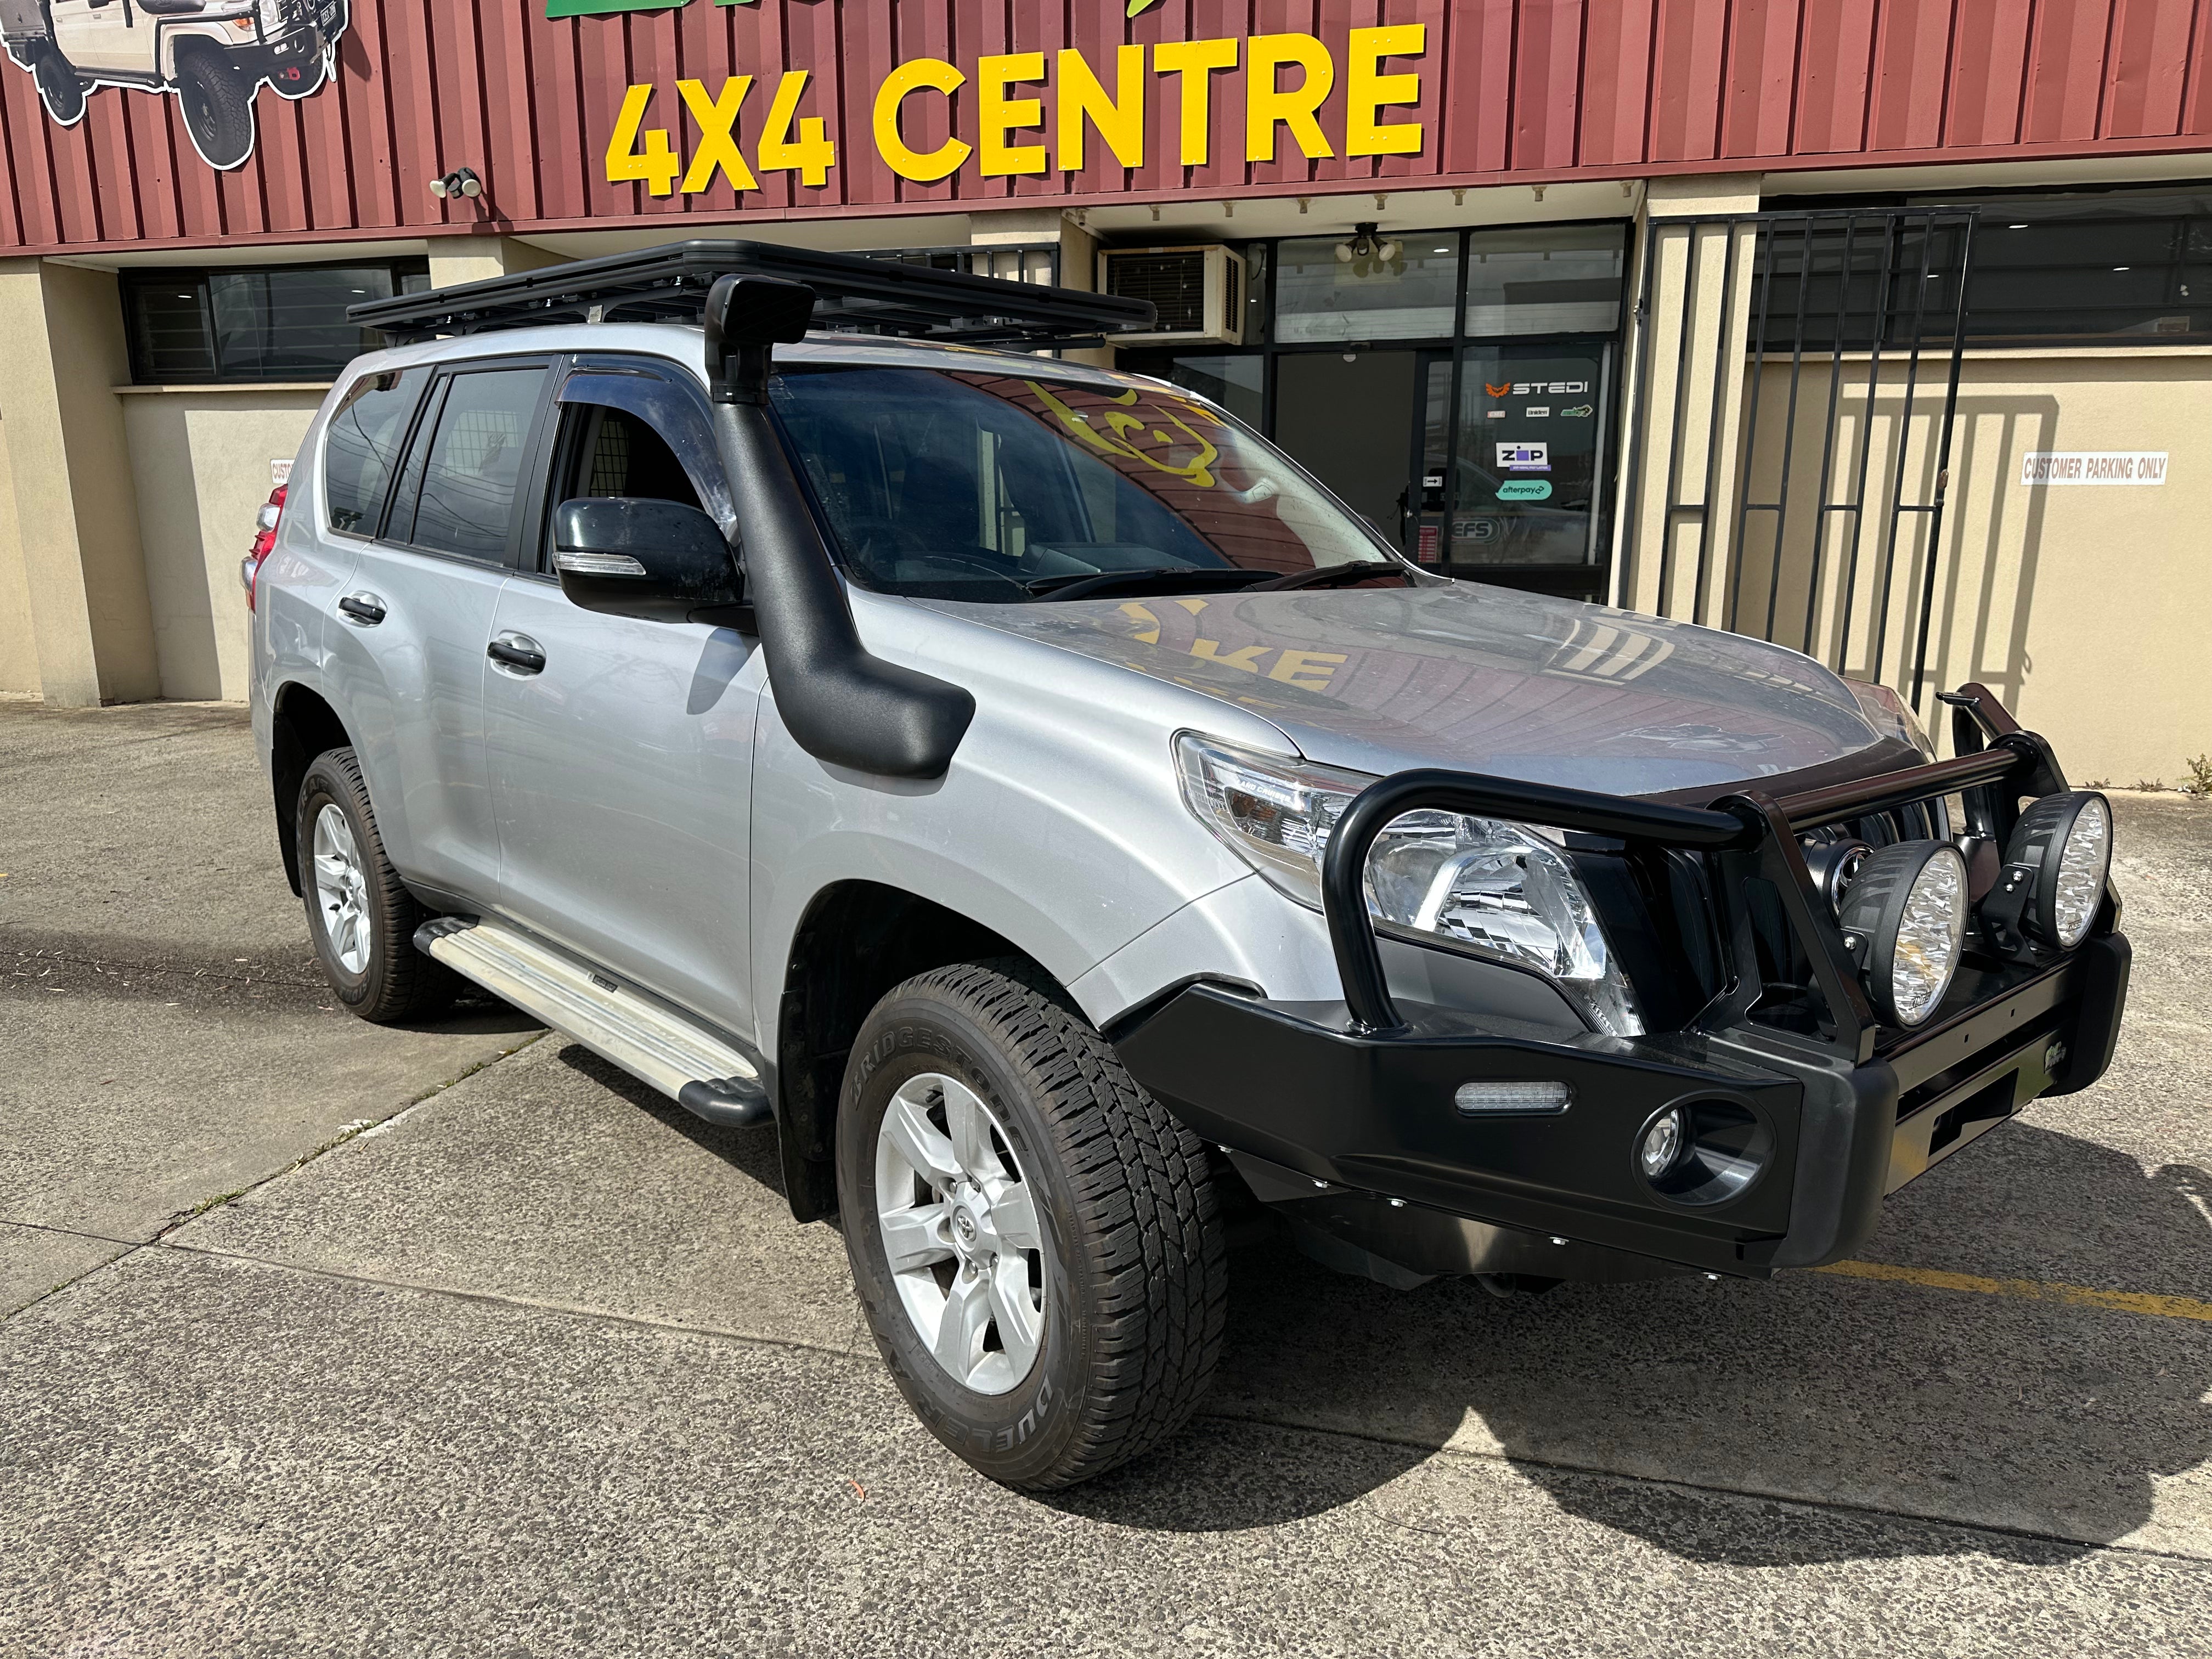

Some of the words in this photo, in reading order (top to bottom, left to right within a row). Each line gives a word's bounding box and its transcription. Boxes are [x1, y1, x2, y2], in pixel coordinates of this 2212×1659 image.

[606, 70, 836, 196] 4X4
[873, 23, 1425, 182] CENTRE
[1513, 381, 1589, 395] STEDI
[272, 462, 294, 479] CUSTO
[2024, 457, 2082, 479] CUSTOMER
[2086, 457, 2133, 479] PARKING
[2138, 457, 2166, 479] ONLY
[1503, 486, 1536, 494] afterpay
[1452, 522, 1489, 537] EFS
[1256, 786, 1291, 803] CRUISER
[850, 1026, 1030, 1152] BRIDGESTONE
[916, 1371, 1054, 1454] DUELER
